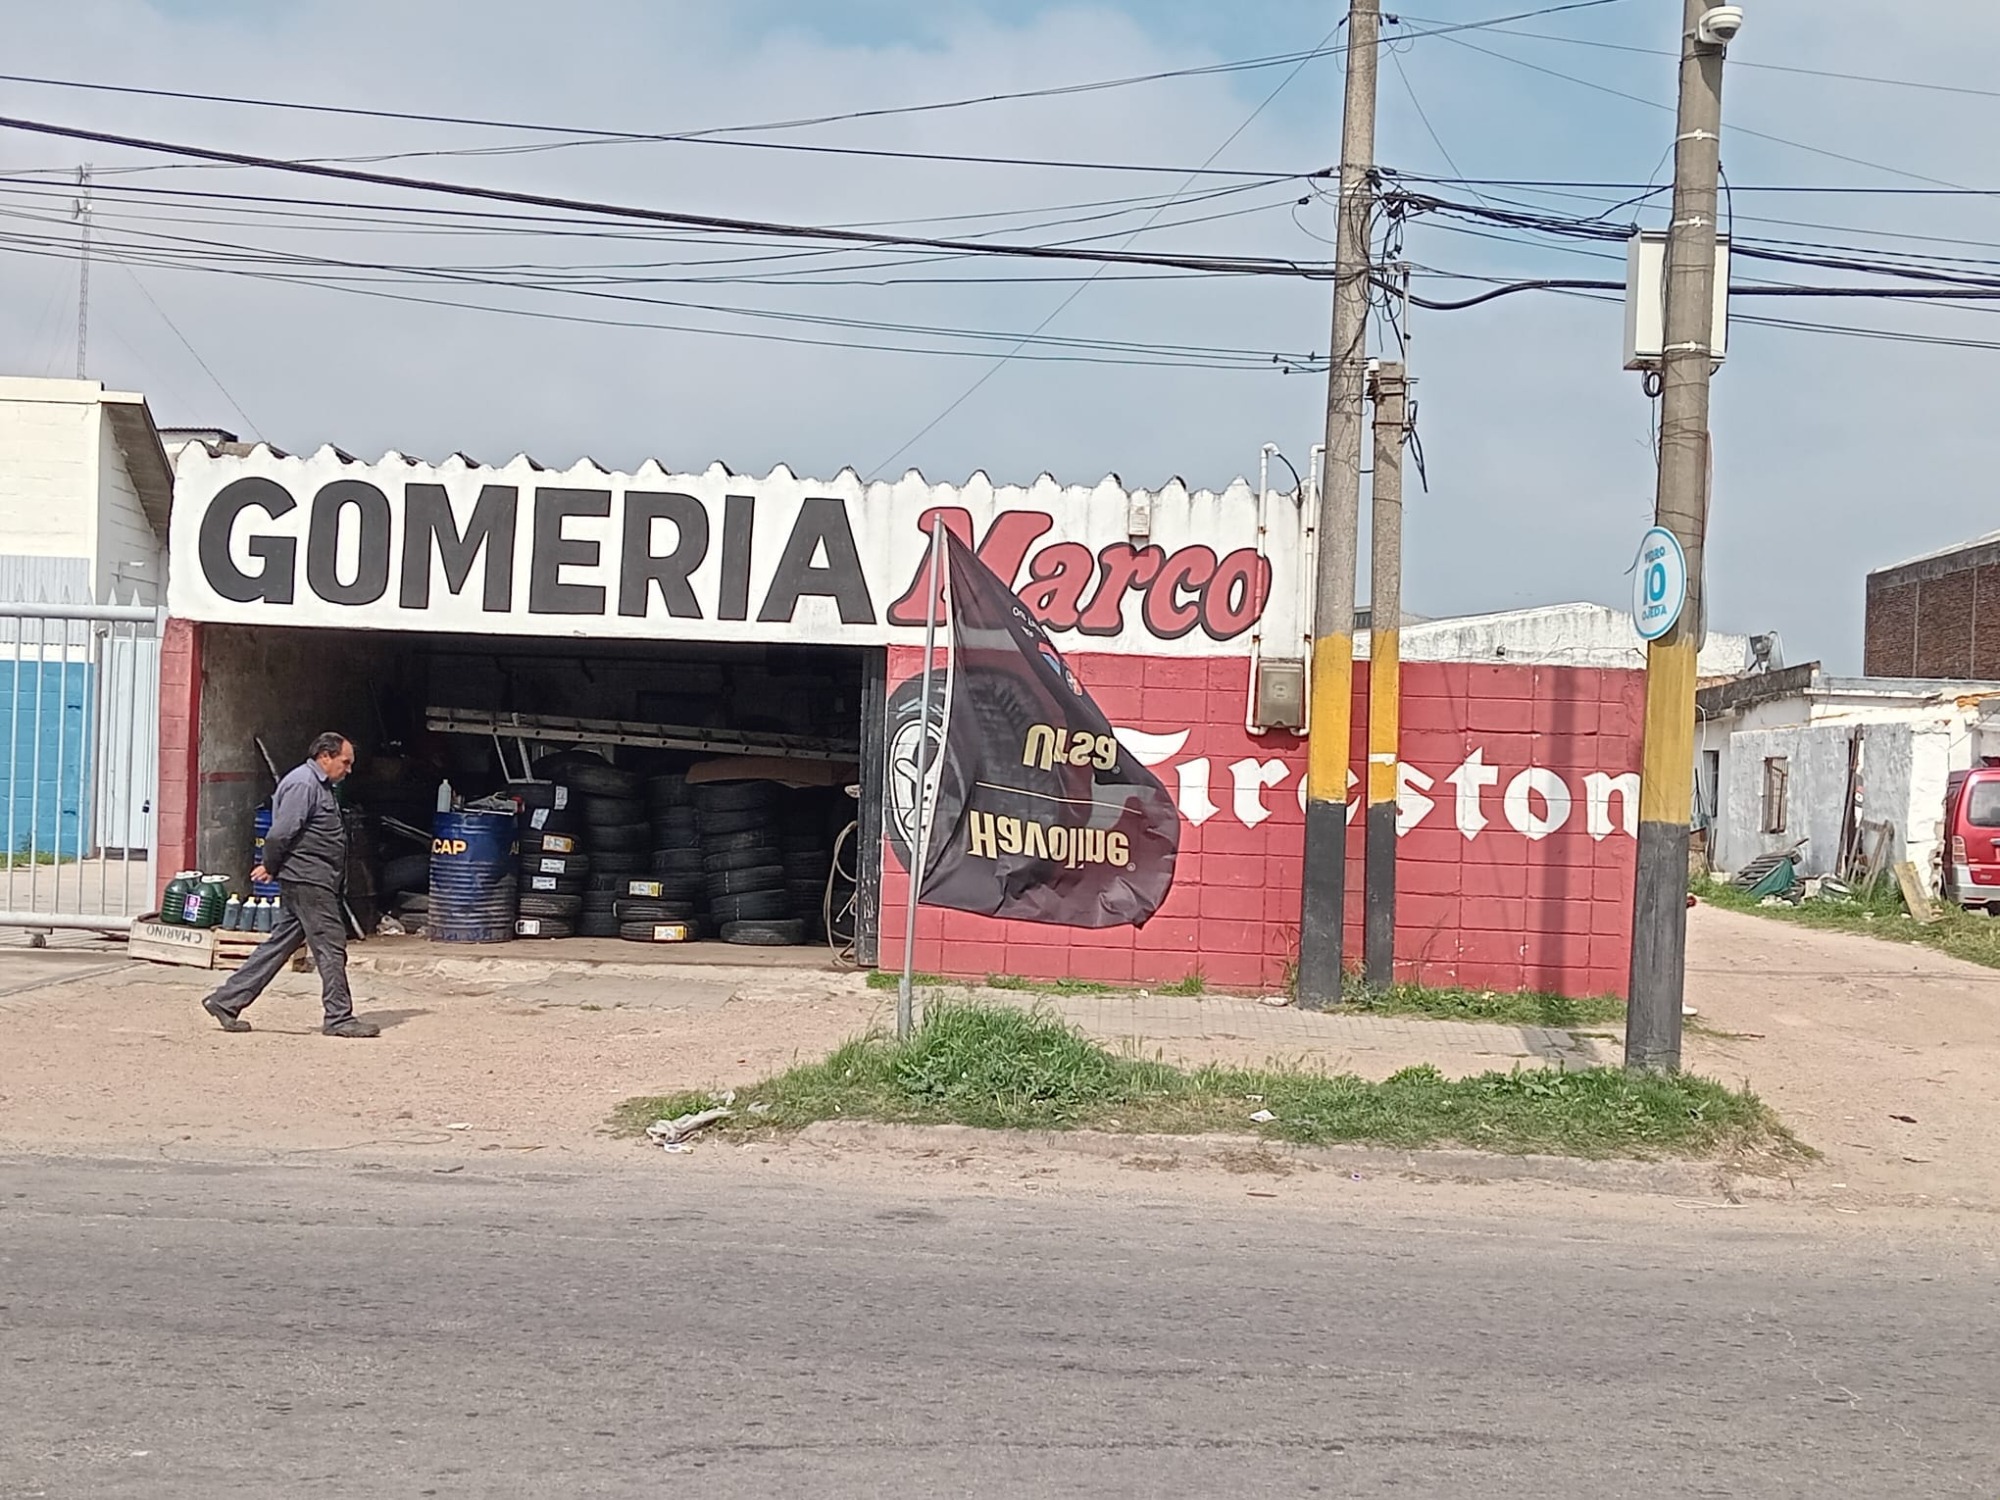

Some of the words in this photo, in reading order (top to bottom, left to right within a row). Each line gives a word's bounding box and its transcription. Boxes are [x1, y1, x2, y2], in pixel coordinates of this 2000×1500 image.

[199, 477, 876, 625] GOMERIA
[887, 507, 1271, 641] Marco
[1643, 563, 1666, 605] 10
[1642, 605, 1667, 621] OJEDA
[431, 838, 467, 855] CAP
